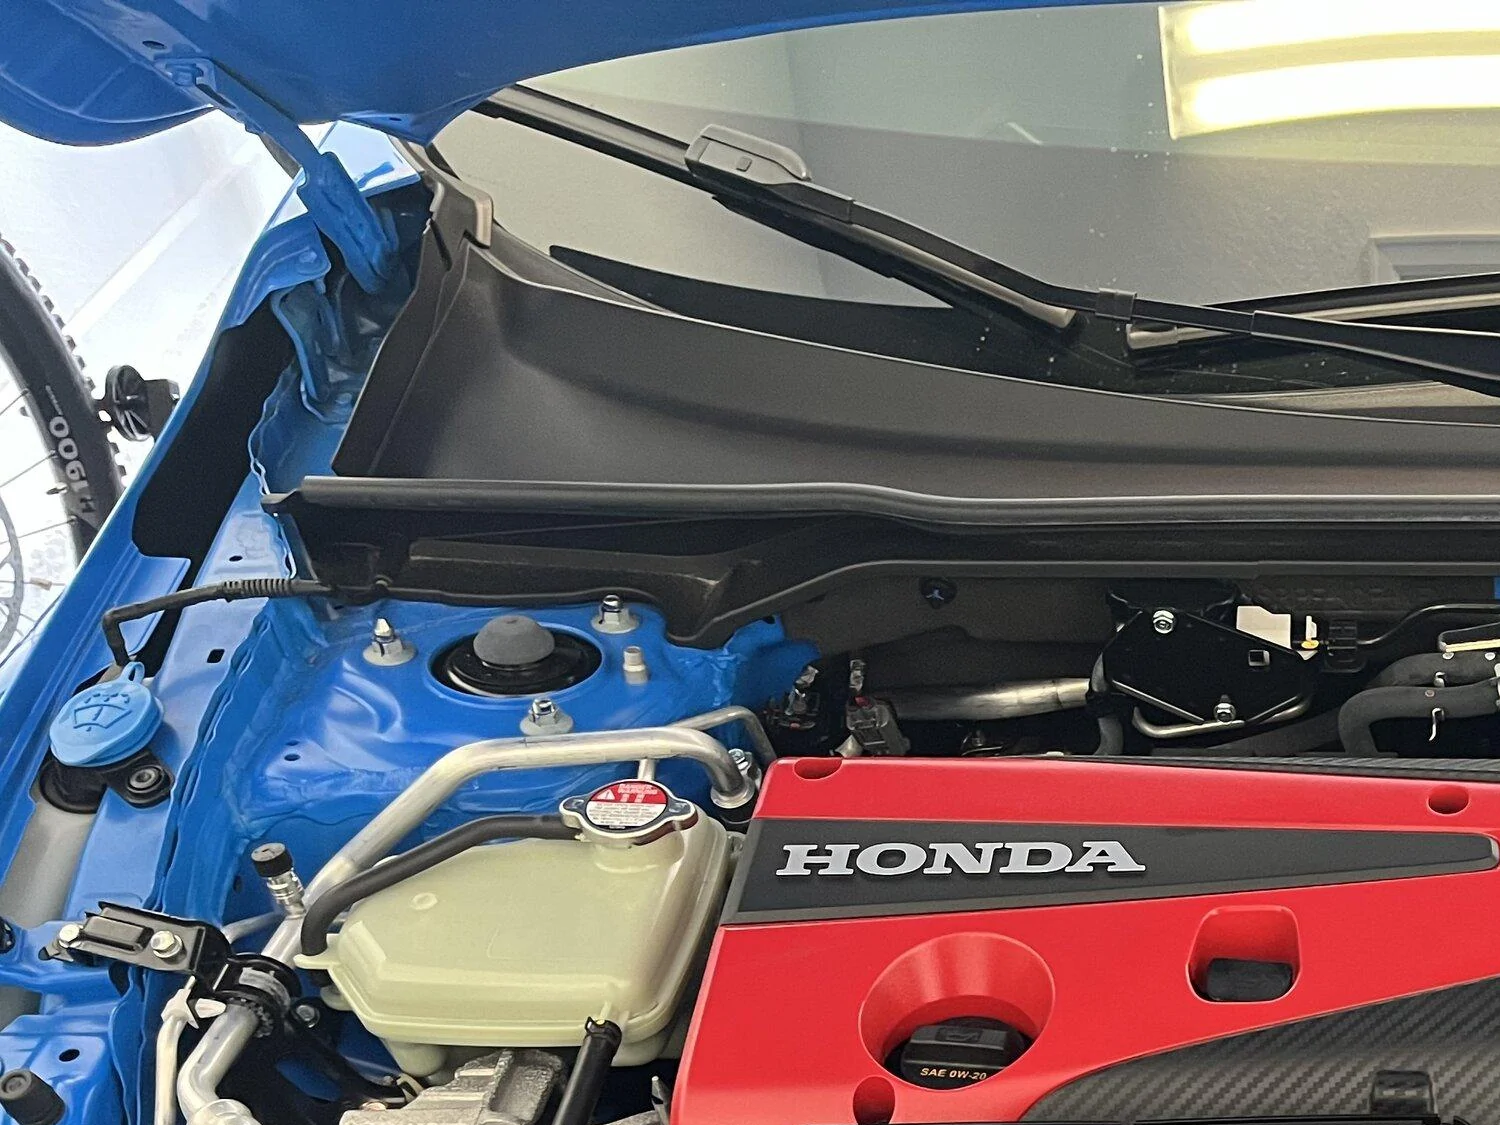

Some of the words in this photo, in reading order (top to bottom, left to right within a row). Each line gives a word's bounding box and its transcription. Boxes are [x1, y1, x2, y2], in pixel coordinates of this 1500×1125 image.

[775, 841, 1146, 876] HONDA
[920, 1067, 947, 1078] SAE
[949, 1069, 987, 1081] 0W-20
